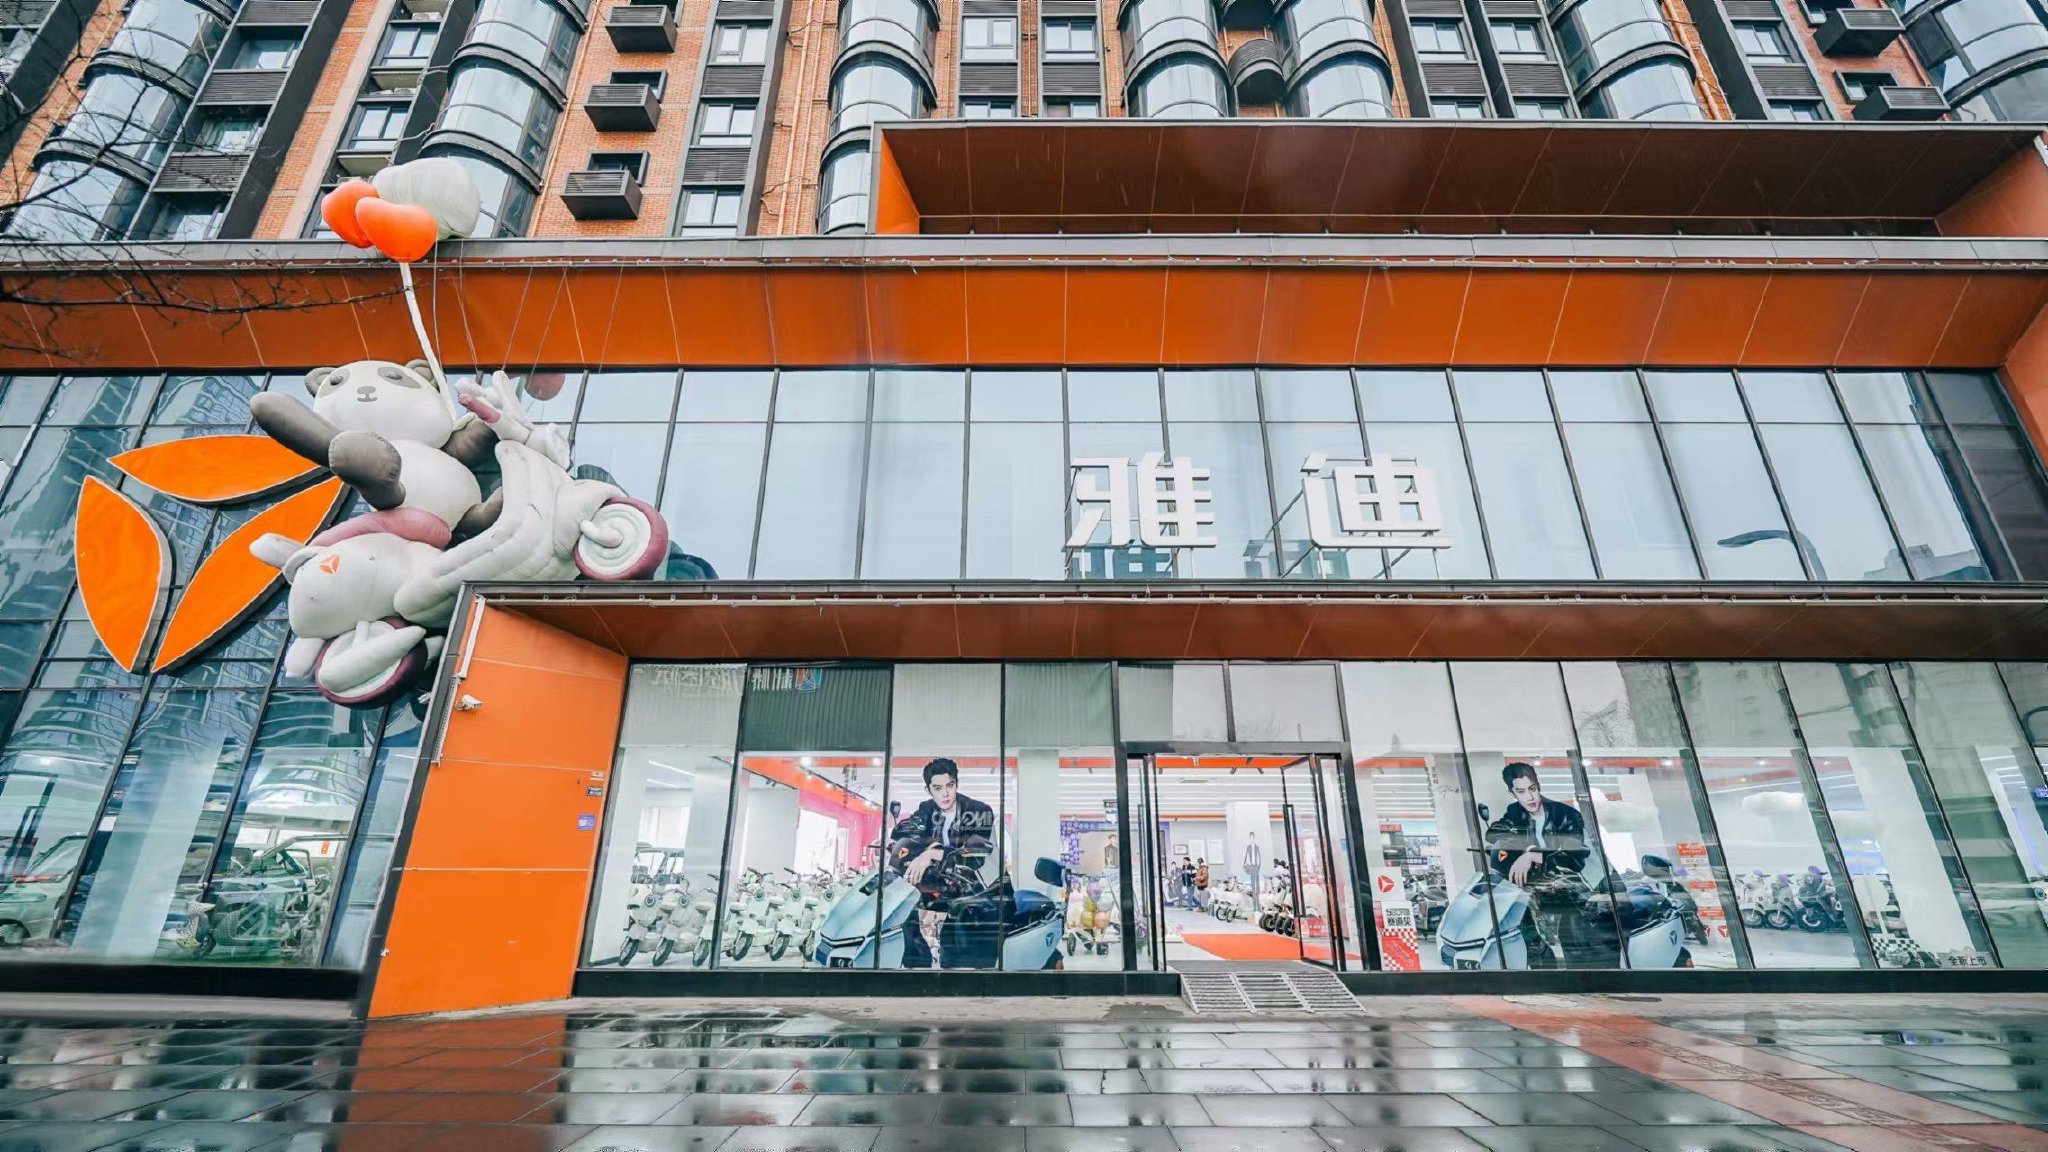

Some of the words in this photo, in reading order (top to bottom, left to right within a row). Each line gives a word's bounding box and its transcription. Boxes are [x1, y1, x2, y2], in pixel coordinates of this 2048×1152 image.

[1066, 452, 1456, 549] 雅迪
[1947, 955, 1988, 966] 全新上市
